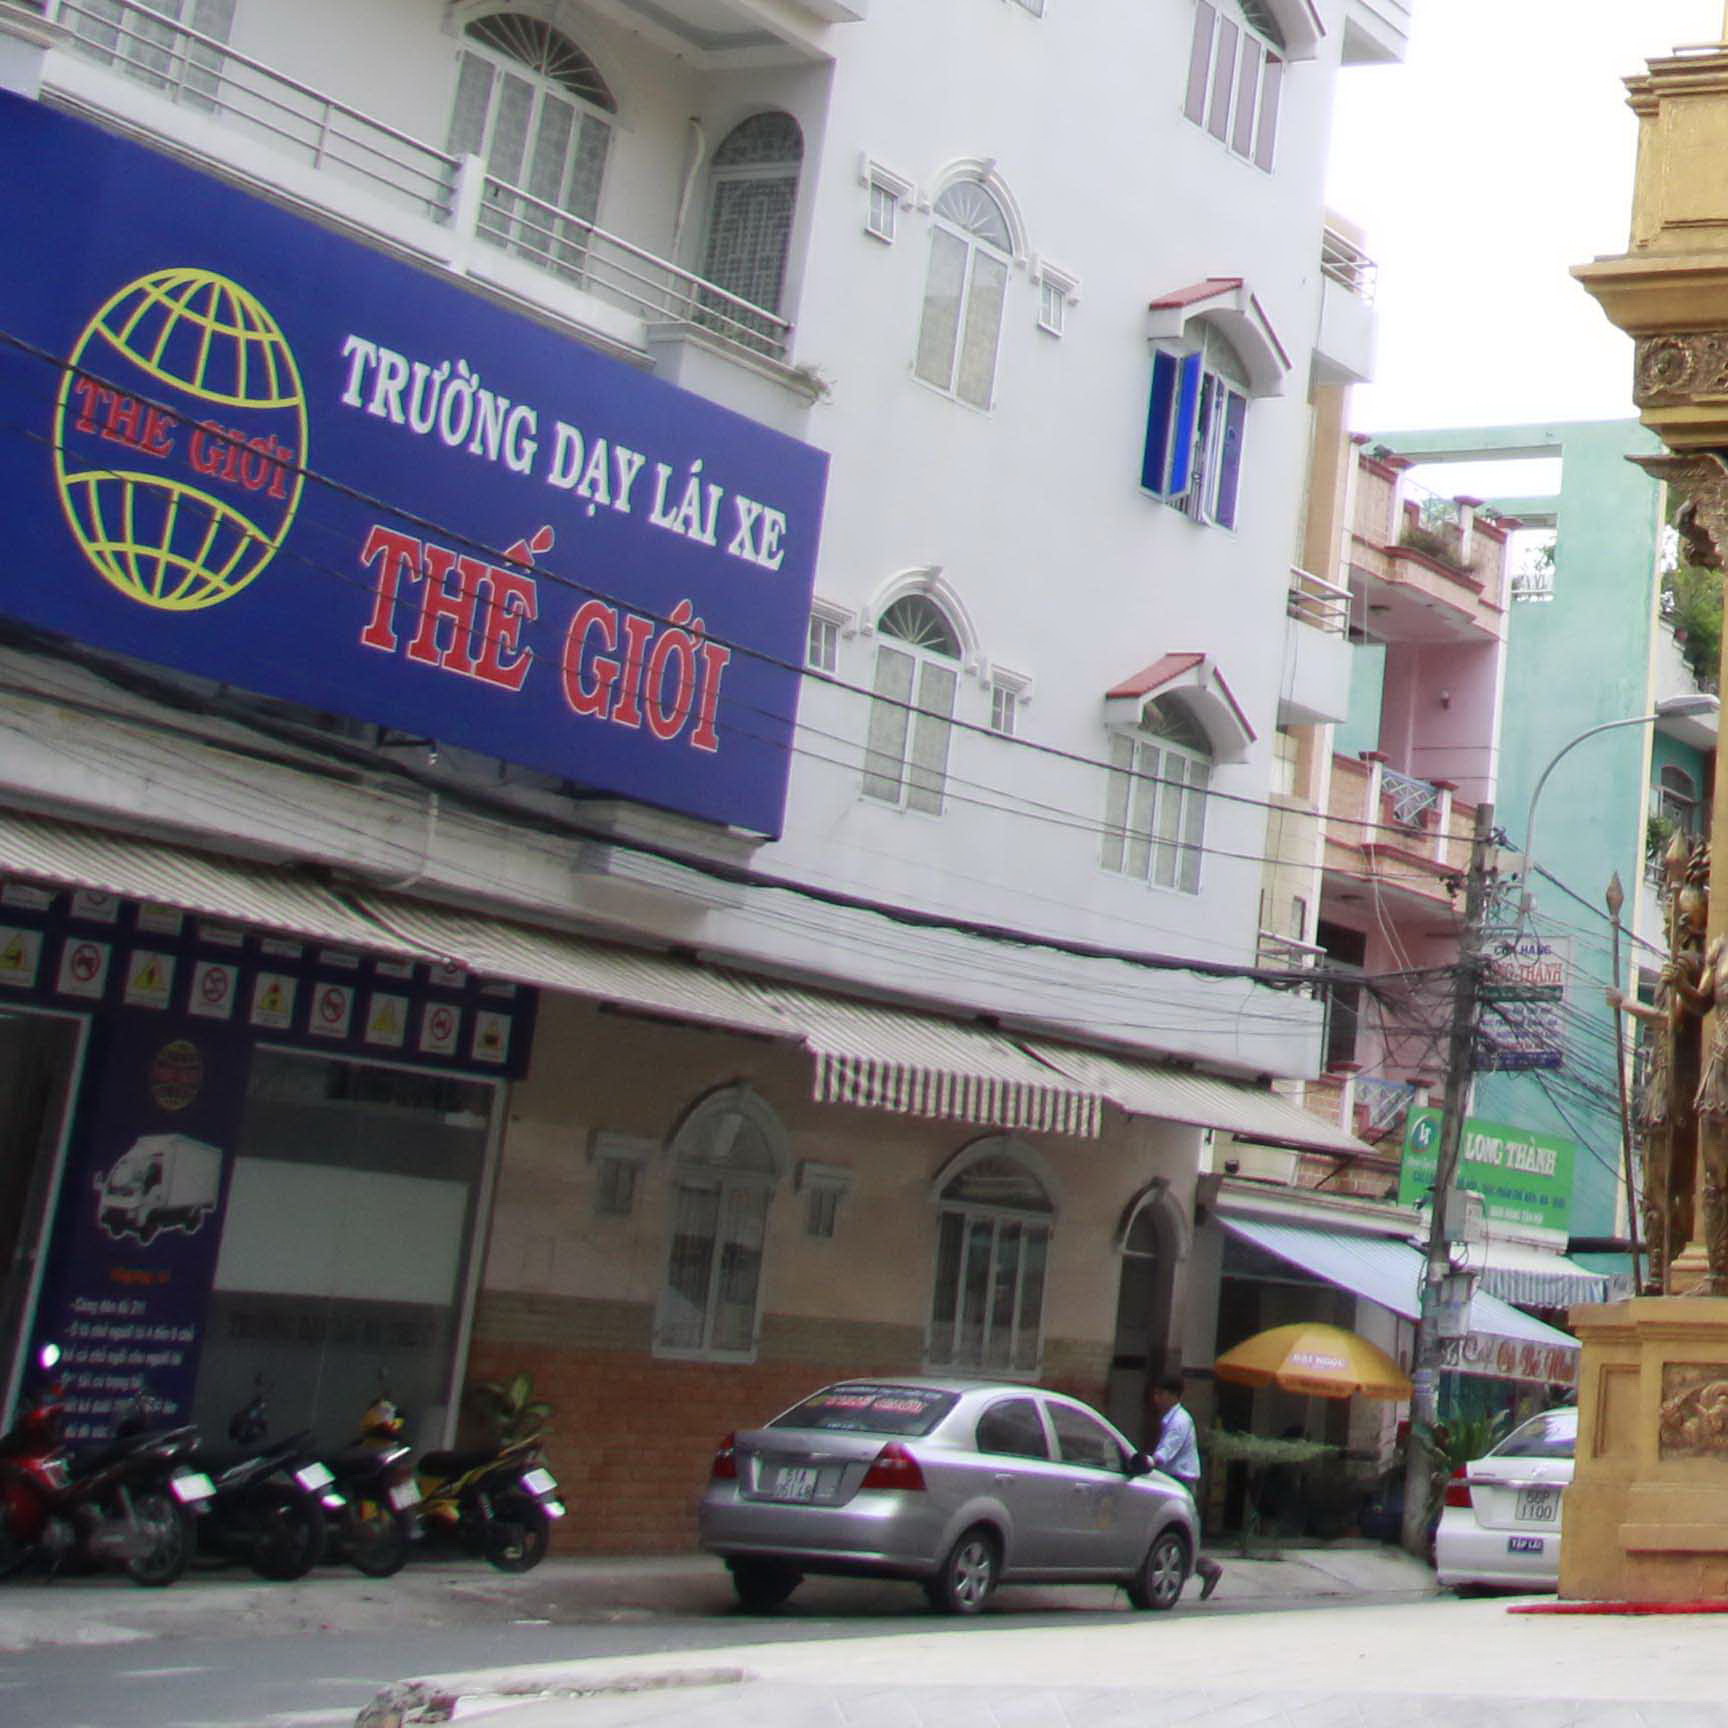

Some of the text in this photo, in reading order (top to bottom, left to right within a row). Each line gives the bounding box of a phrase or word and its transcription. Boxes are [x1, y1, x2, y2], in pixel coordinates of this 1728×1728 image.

[341, 334, 788, 572] TRƯỜNG DẠY LÁI XE
[360, 524, 732, 753] THẾ GIỚI
[1464, 1133, 1503, 1166] LONG
[1505, 1136, 1558, 1177] THÀNH
